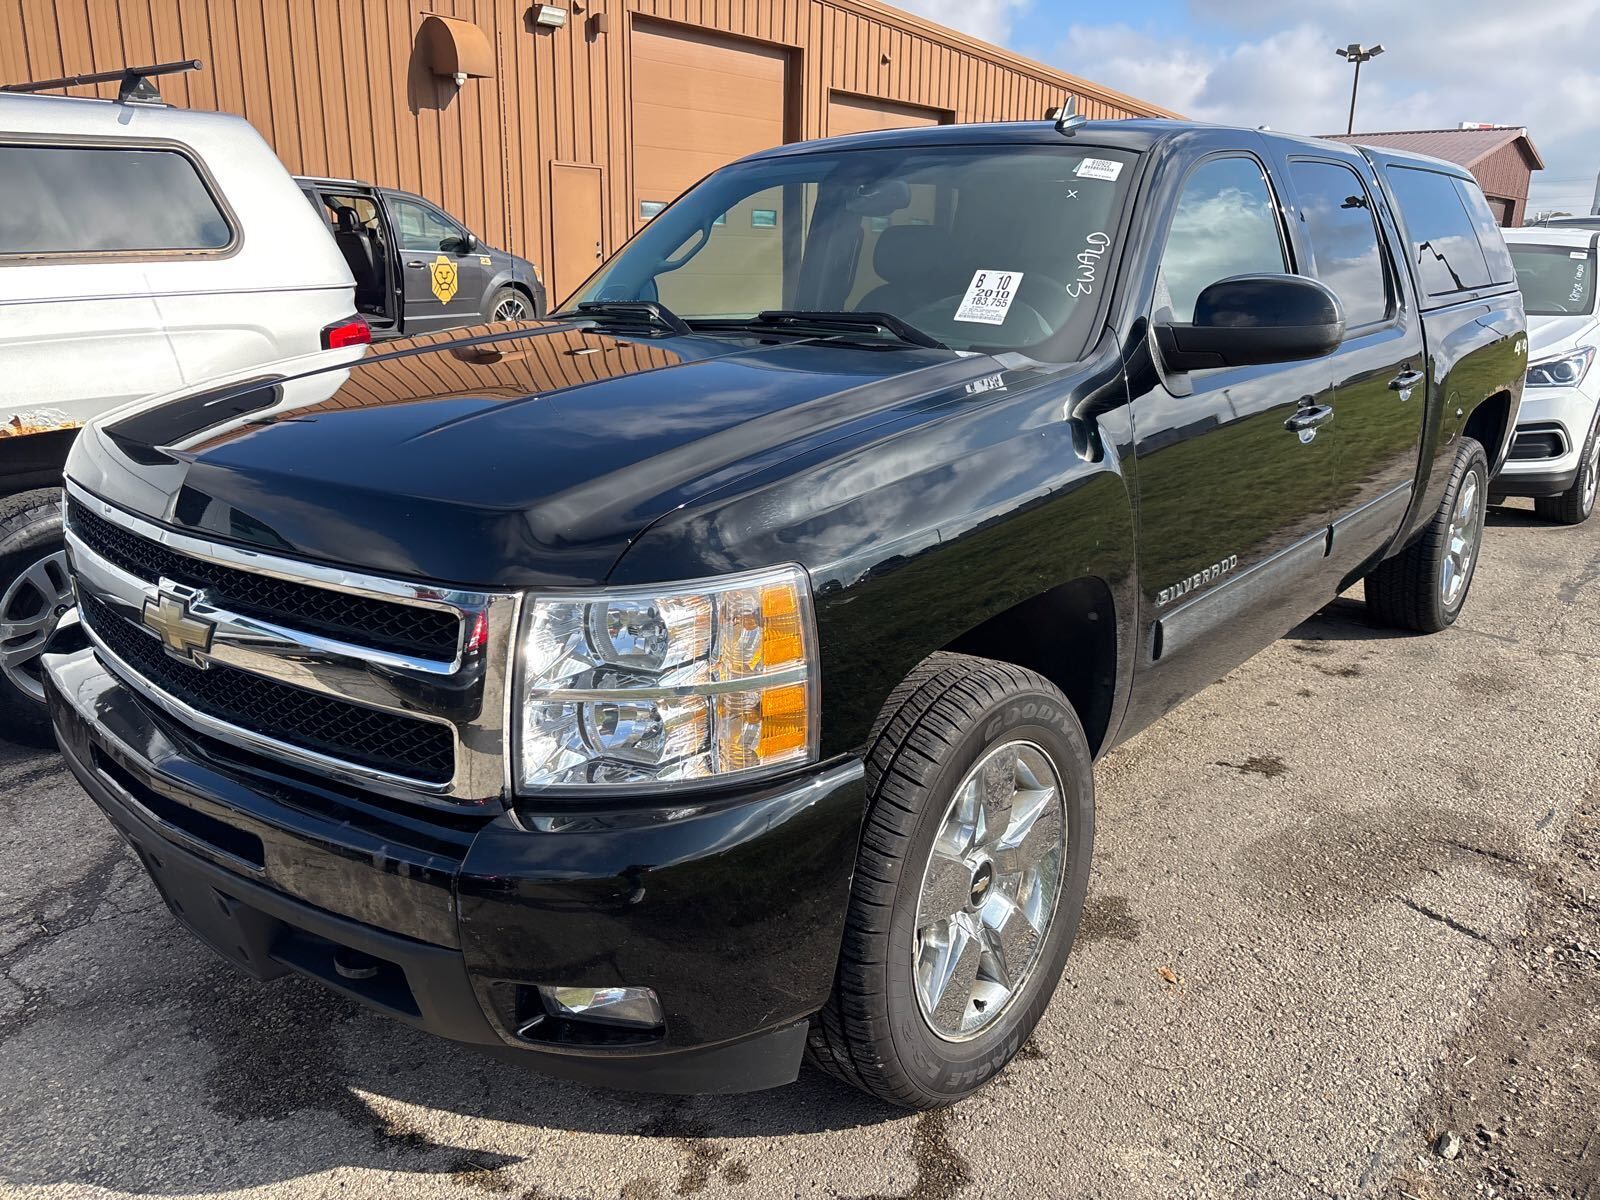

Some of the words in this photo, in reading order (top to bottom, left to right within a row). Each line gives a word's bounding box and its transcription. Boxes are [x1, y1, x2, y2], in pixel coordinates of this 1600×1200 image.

[975, 273, 986, 288] B
[996, 275, 1012, 290] 10
[1066, 231, 1110, 298] EWALD
[971, 296, 1008, 308] 183,755
[975, 288, 1010, 299] 2010
[1155, 554, 1238, 607] SILVERADO
[946, 1034, 1019, 1086] EAGLE
